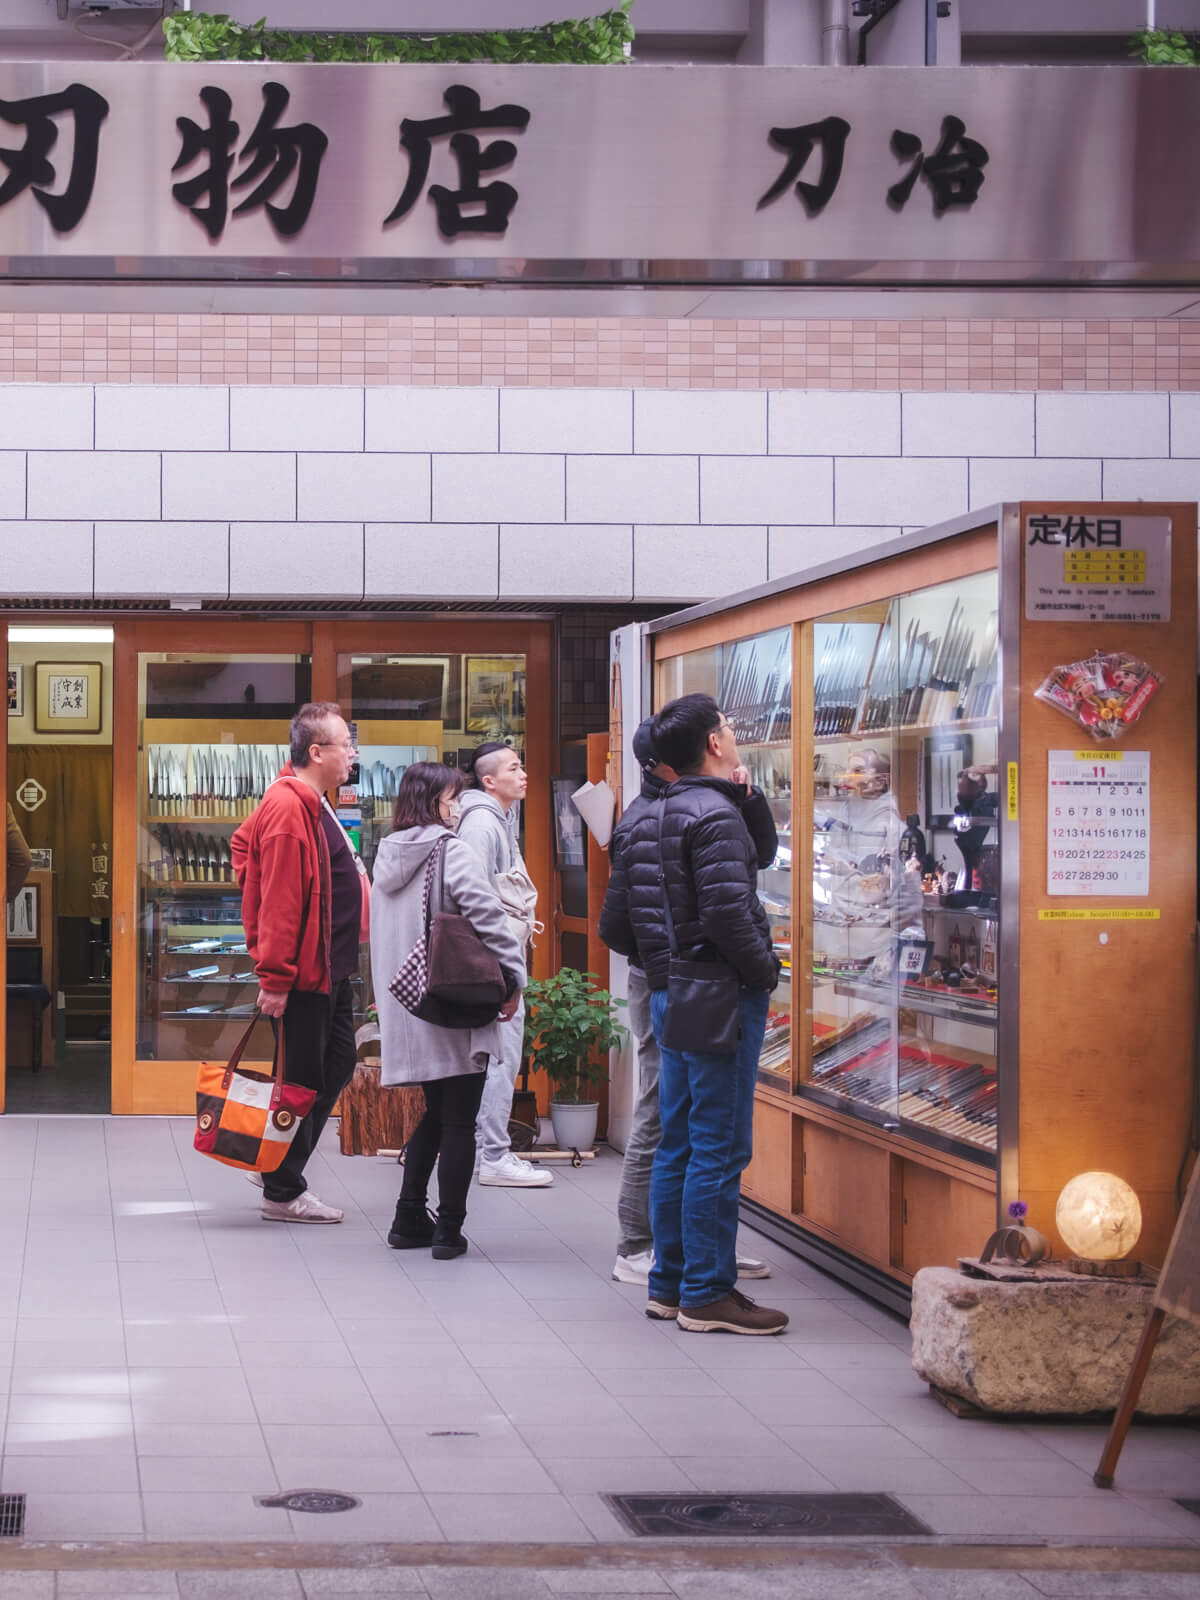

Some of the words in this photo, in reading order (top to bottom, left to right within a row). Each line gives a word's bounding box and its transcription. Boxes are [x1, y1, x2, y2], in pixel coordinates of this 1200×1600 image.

[1029, 515, 1122, 547] 定休日
[1093, 767, 1106, 778] 11
[1096, 787, 1102, 795] 1
[1110, 787, 1116, 795] 2
[1123, 787, 1129, 795] 3
[1136, 787, 1143, 795] 4
[1055, 808, 1061, 817] 5
[1068, 808, 1075, 817] 6
[1082, 808, 1088, 817] 7
[1096, 808, 1102, 817] 8
[1109, 808, 1116, 817] 9
[1121, 808, 1133, 817] 10
[1135, 808, 1145, 817] 11
[1052, 829, 1064, 837] 12
[1066, 829, 1078, 837] 13
[1080, 829, 1091, 837] 14
[1093, 829, 1105, 837] 15
[1107, 829, 1119, 837] 16
[1121, 829, 1132, 837] 17
[1135, 829, 1146, 837] 18
[1052, 850, 1064, 859] 19
[1065, 850, 1078, 859] 20
[1079, 850, 1090, 859] 21
[1092, 850, 1105, 859] 22
[1106, 850, 1119, 859] 23
[1120, 850, 1132, 859] 24
[1133, 850, 1146, 859] 25
[1052, 872, 1064, 880] 26
[1065, 872, 1077, 880] 27
[1079, 872, 1091, 880] 28
[1092, 872, 1105, 880] 29
[1105, 872, 1119, 880] 30
